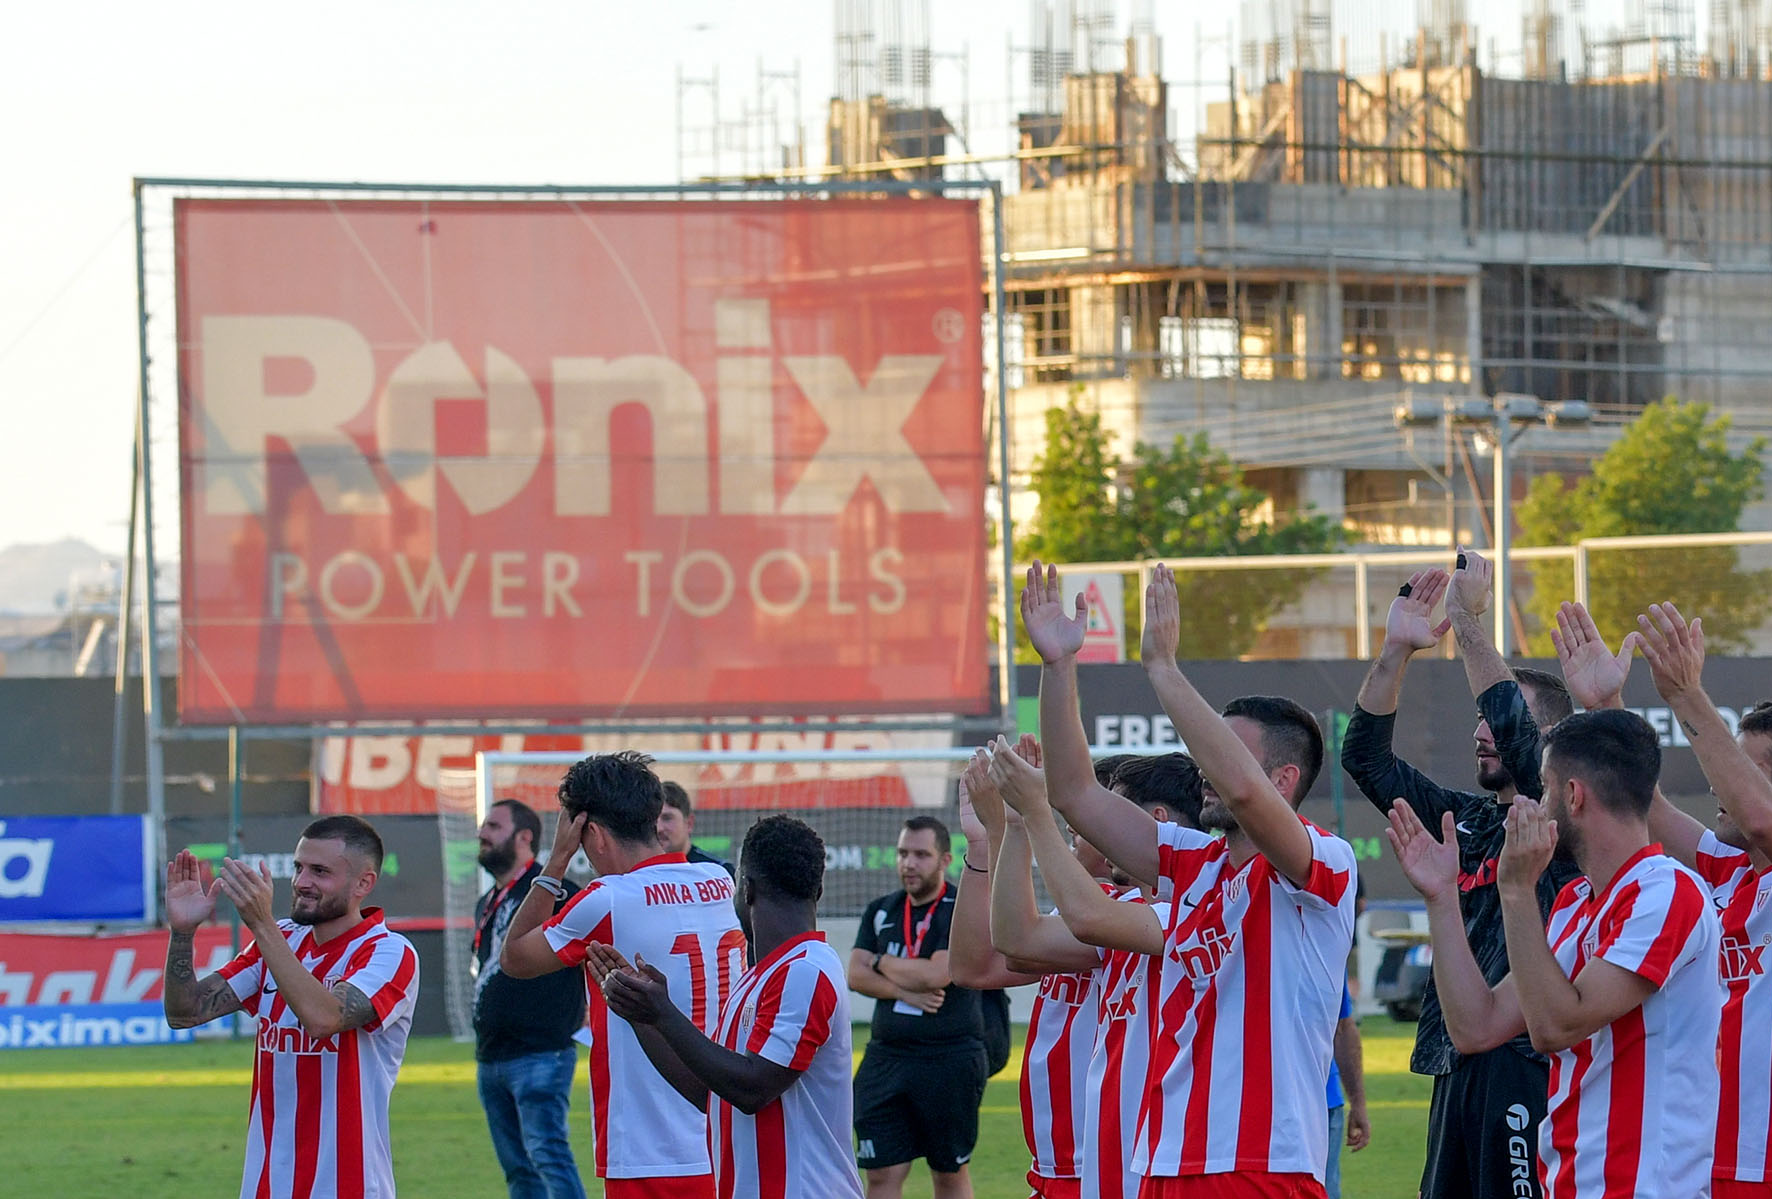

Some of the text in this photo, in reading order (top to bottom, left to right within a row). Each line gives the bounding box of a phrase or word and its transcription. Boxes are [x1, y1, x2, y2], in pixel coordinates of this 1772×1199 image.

[202, 298, 951, 516] Ronix
[272, 548, 907, 620] POWER TOOLS
[643, 882, 695, 907] MIKA
[669, 929, 749, 1036] 10
[0, 1014, 195, 1045] iximan
